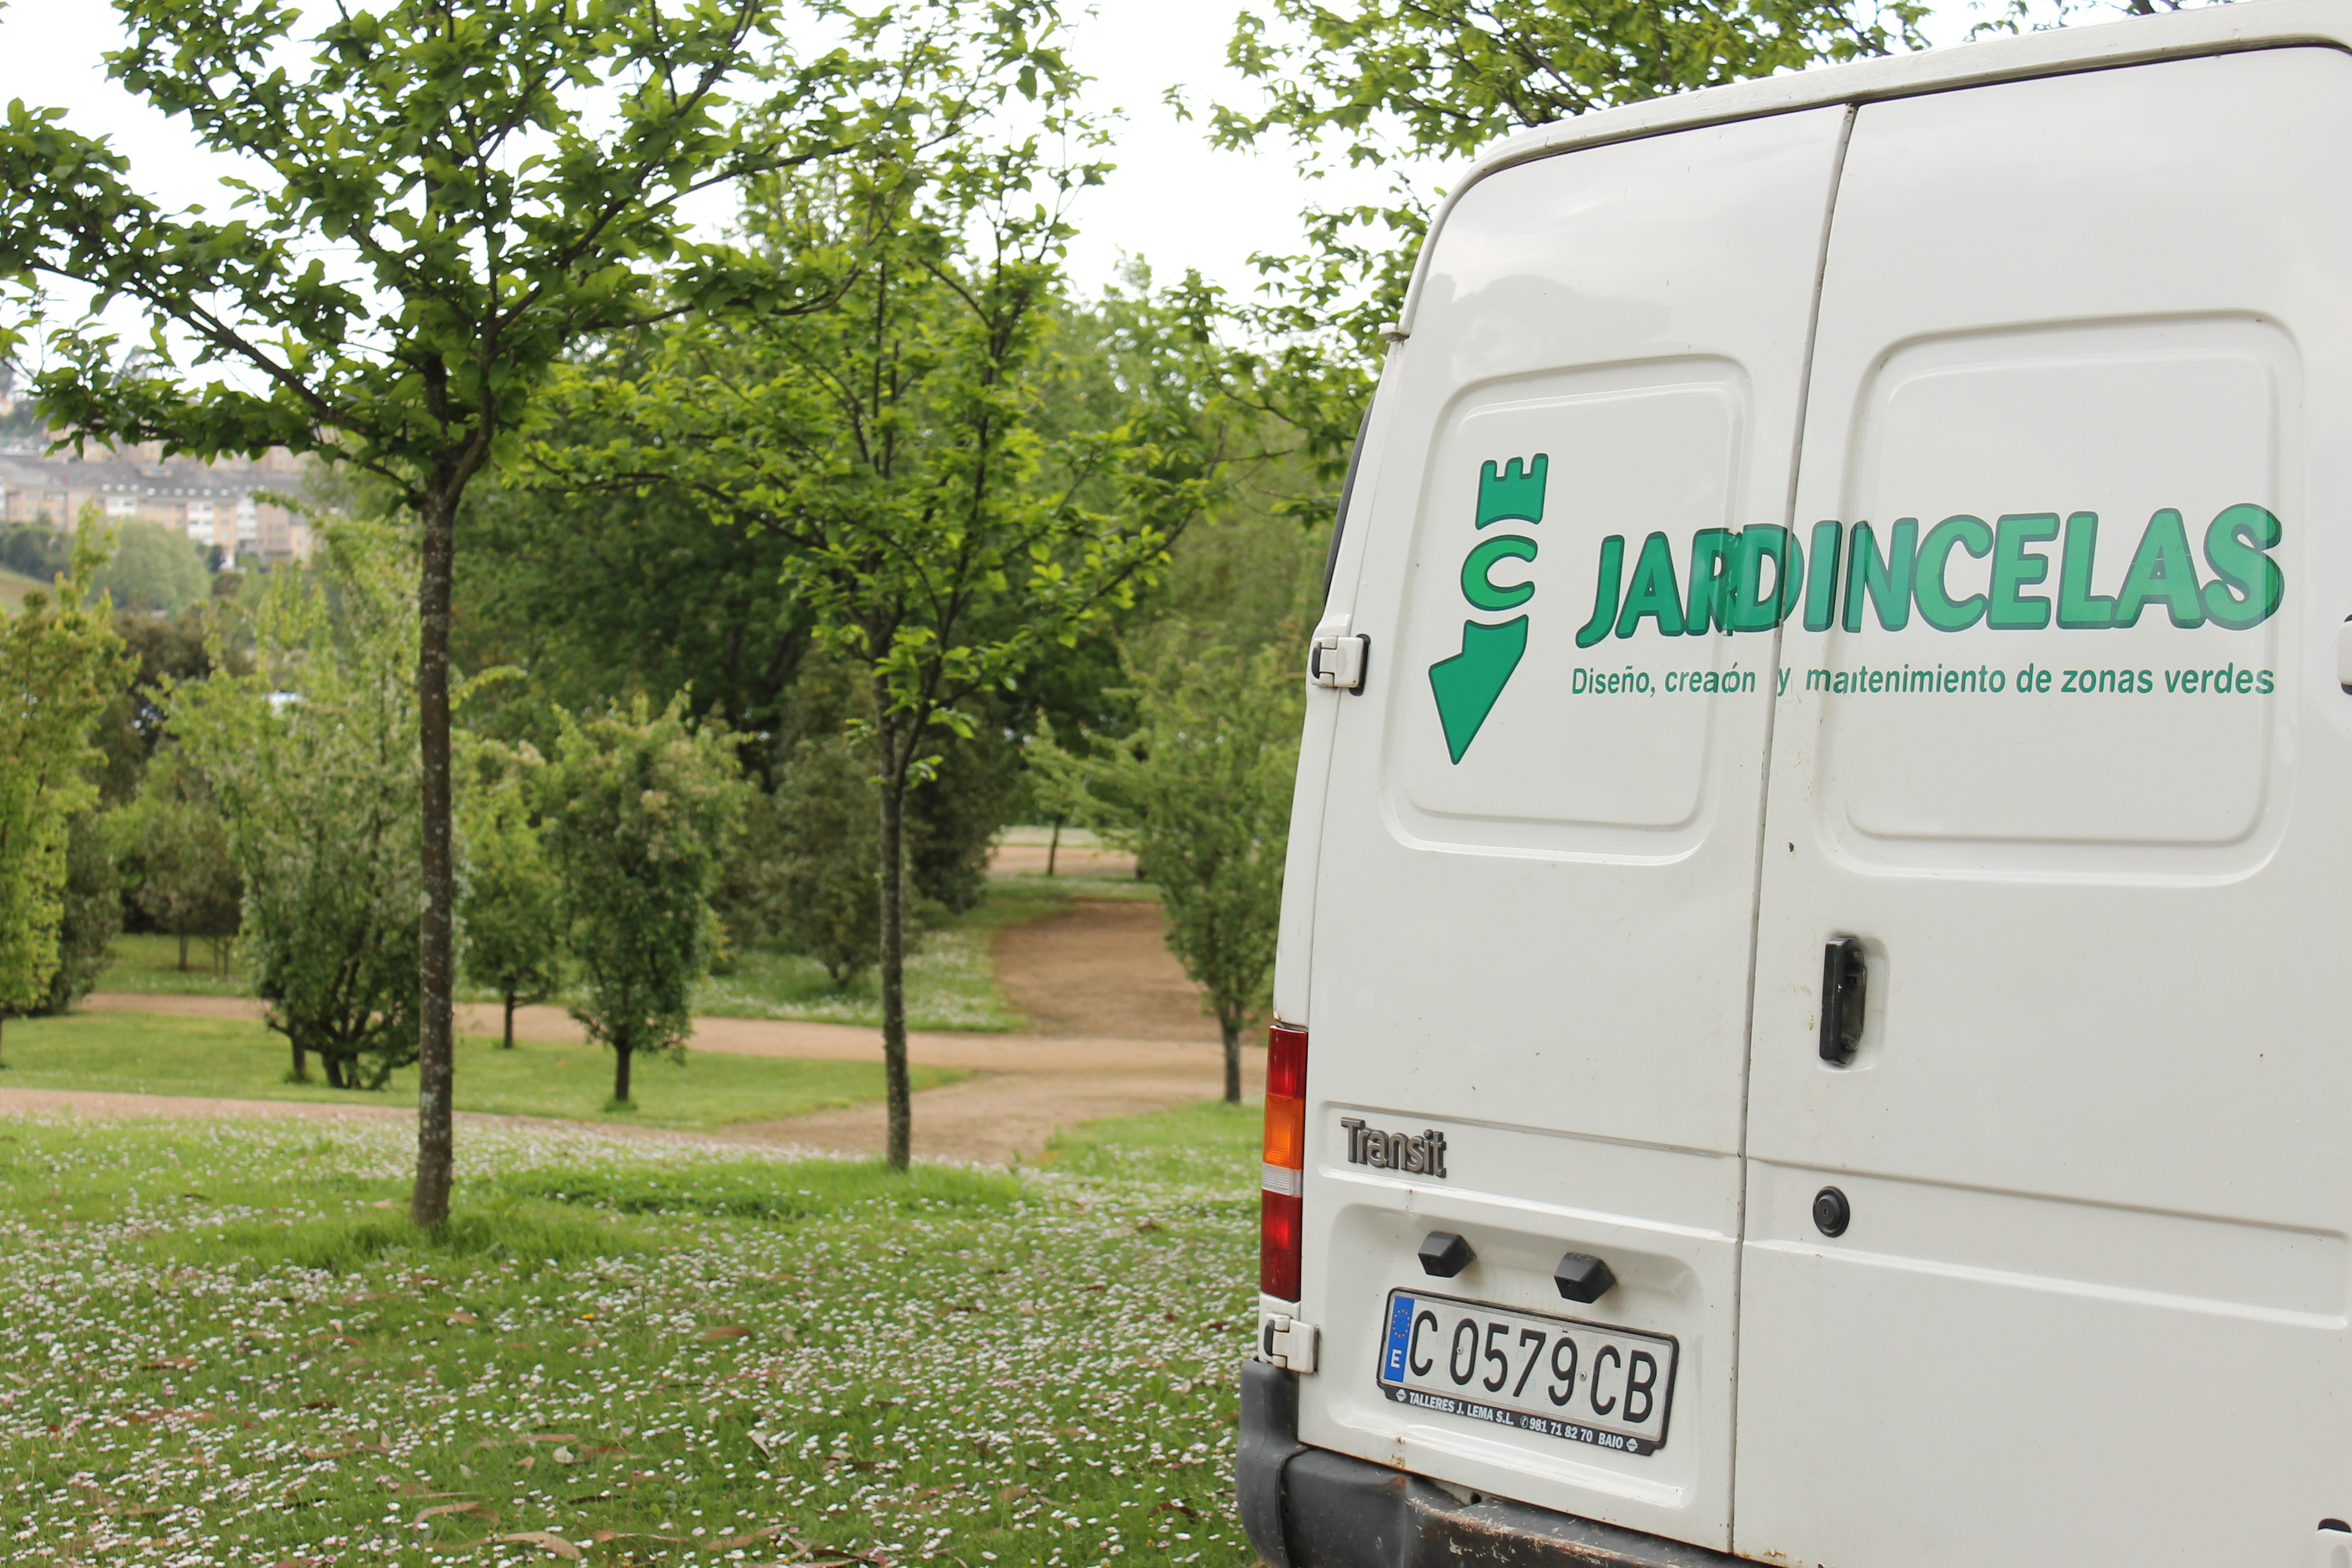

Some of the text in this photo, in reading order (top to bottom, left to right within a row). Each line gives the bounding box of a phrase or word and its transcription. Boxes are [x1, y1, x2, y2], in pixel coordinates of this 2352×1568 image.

[1575, 503, 2285, 648] JARDINCELAS
[1572, 665, 1655, 697] Diseño,
[1664, 662, 1755, 693] creacón
[1777, 667, 1791, 697] y
[2016, 663, 2052, 693] de
[2061, 668, 2153, 694] zonas
[2165, 662, 2275, 694] verdes
[1340, 1117, 1447, 1178] Transit
[1390, 1349, 1402, 1369] E
[1409, 1392, 1624, 1450] TALLERES J. LEMA S.L. 981 71 82 70 BAIO
